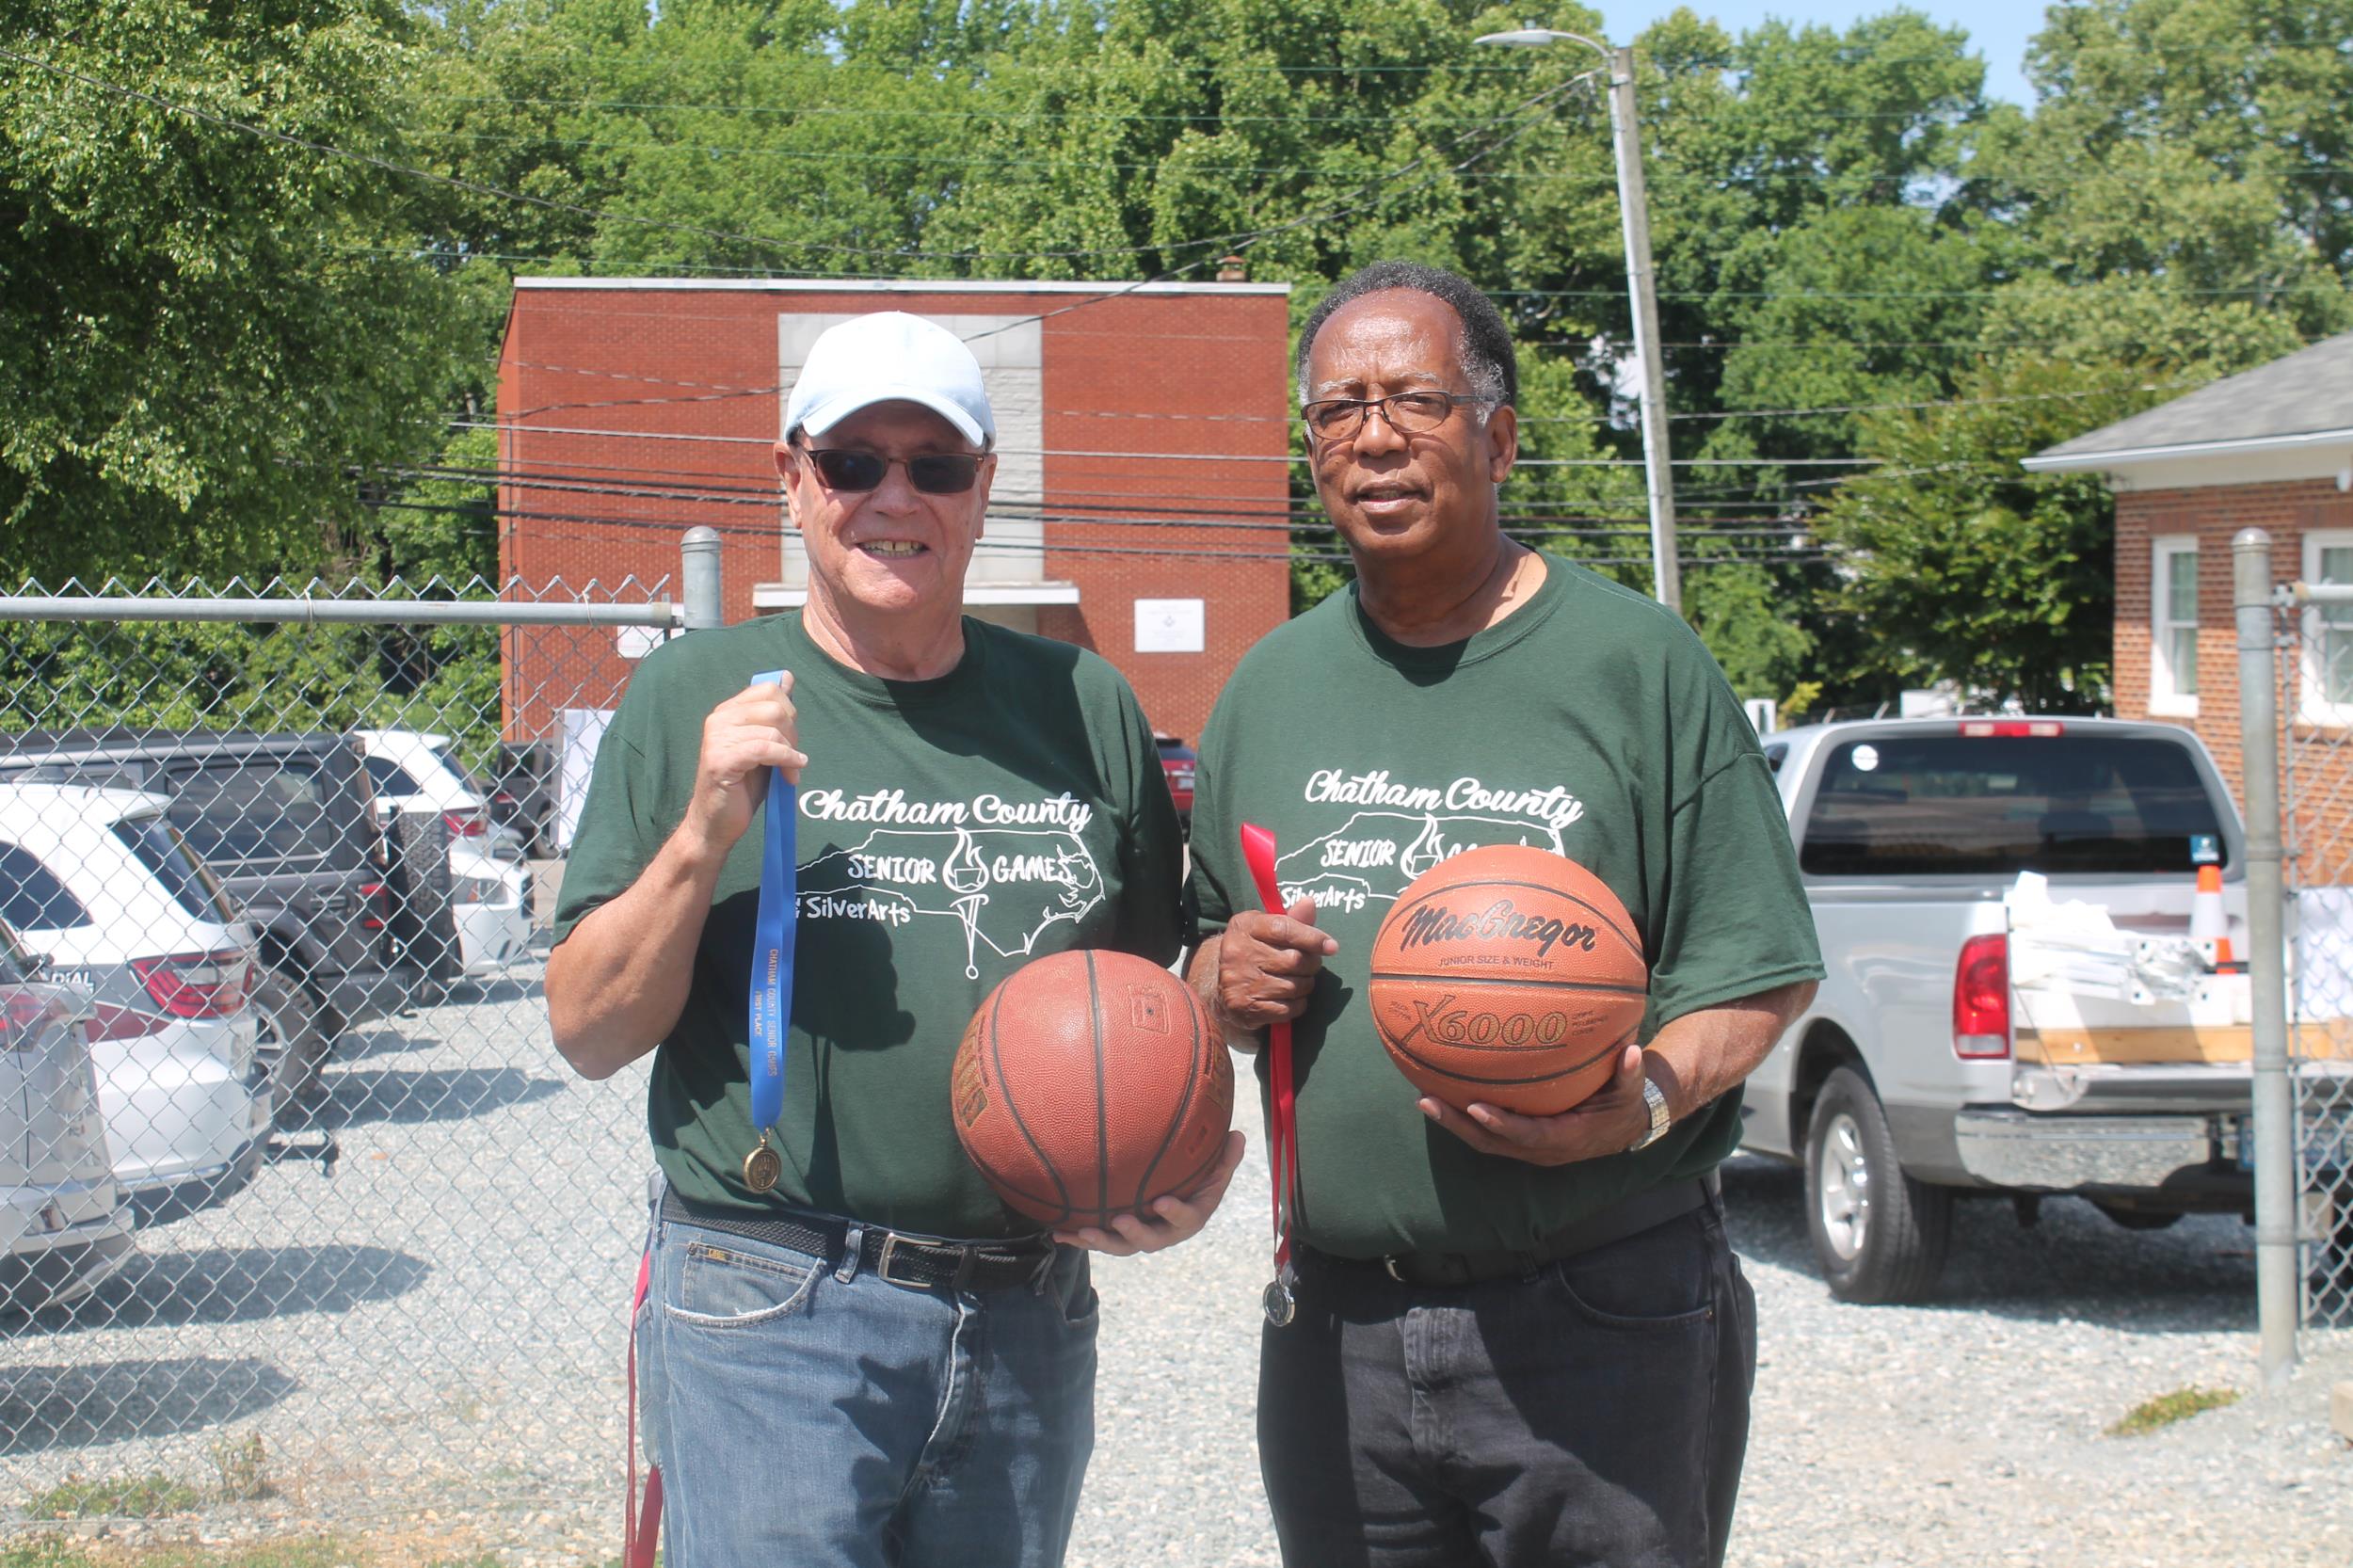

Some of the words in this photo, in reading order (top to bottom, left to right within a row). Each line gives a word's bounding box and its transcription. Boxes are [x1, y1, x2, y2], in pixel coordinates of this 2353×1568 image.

[799, 789, 969, 824] Chatham
[972, 792, 1092, 832] County
[1305, 769, 1441, 809] Chatham
[1445, 776, 1584, 829] County
[847, 854, 937, 884] SENIOR
[992, 855, 1072, 883] GAMES
[1320, 839, 1395, 868] SENIOR
[806, 896, 911, 927] SilverArts
[1401, 900, 1595, 957] MacGregor
[1438, 955, 1475, 967] JUNIOR
[1477, 955, 1500, 965] SIZE
[1502, 956, 1510, 965] &
[1513, 956, 1554, 970] WEIGHT
[1401, 994, 1568, 1047] X6000
